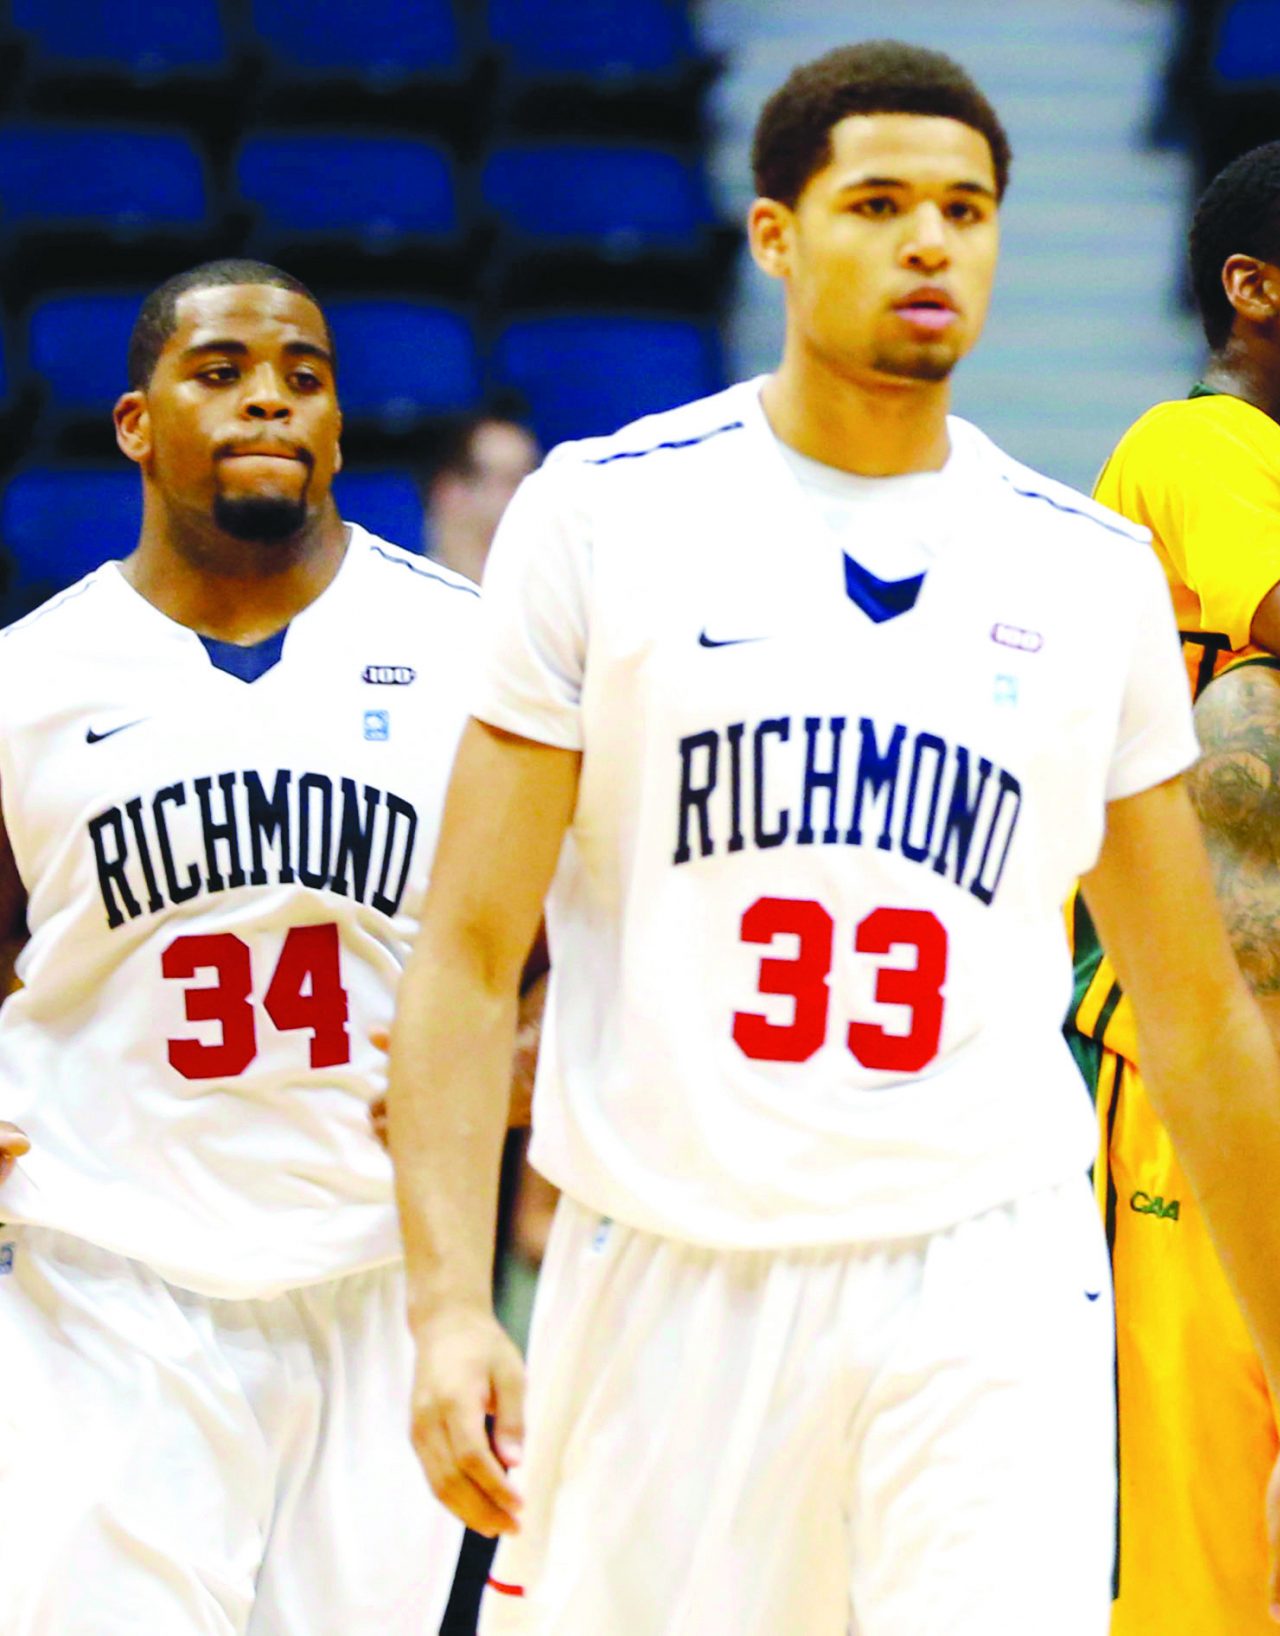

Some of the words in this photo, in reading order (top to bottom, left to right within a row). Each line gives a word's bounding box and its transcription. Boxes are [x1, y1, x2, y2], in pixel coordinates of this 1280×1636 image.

[88, 769, 418, 929] RICHMOND
[672, 715, 1022, 906] RICHMOND
[161, 923, 350, 1080] 34
[732, 896, 948, 1072] 33
[1130, 1191, 1180, 1221] CAA
